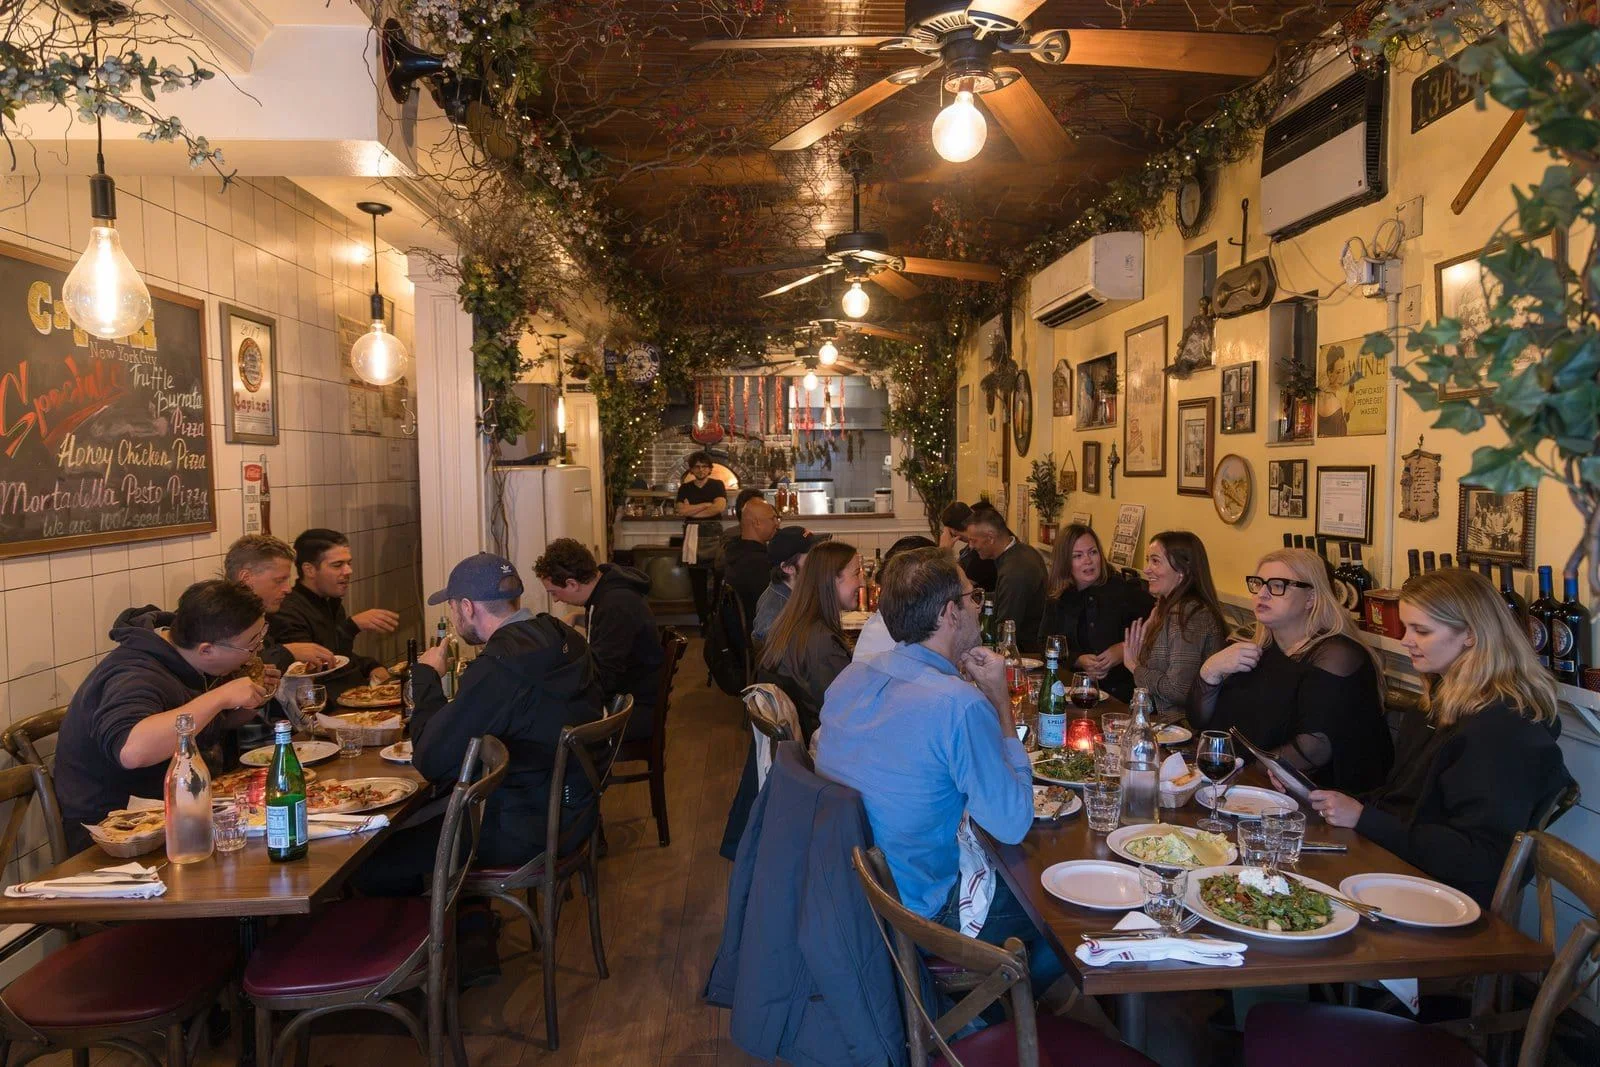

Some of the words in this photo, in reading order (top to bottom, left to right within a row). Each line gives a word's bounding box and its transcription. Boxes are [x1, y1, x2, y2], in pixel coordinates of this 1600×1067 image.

[89, 341, 115, 359] New
[117, 347, 139, 364] York
[139, 350, 157, 366] City
[130, 364, 175, 390] Truffle
[153, 386, 203, 416] Burrata
[234, 391, 270, 413] Capizzi
[171, 408, 205, 438] Pizza
[57, 432, 114, 487] Honey
[117, 439, 171, 466] Chicken
[172, 438, 206, 469] Pizza
[0, 477, 119, 515] Mortadella
[121, 473, 163, 504] Pesto
[167, 475, 209, 506] Pizza
[43, 519, 64, 537] We
[69, 519, 93, 533] are
[133, 507, 162, 527] seed
